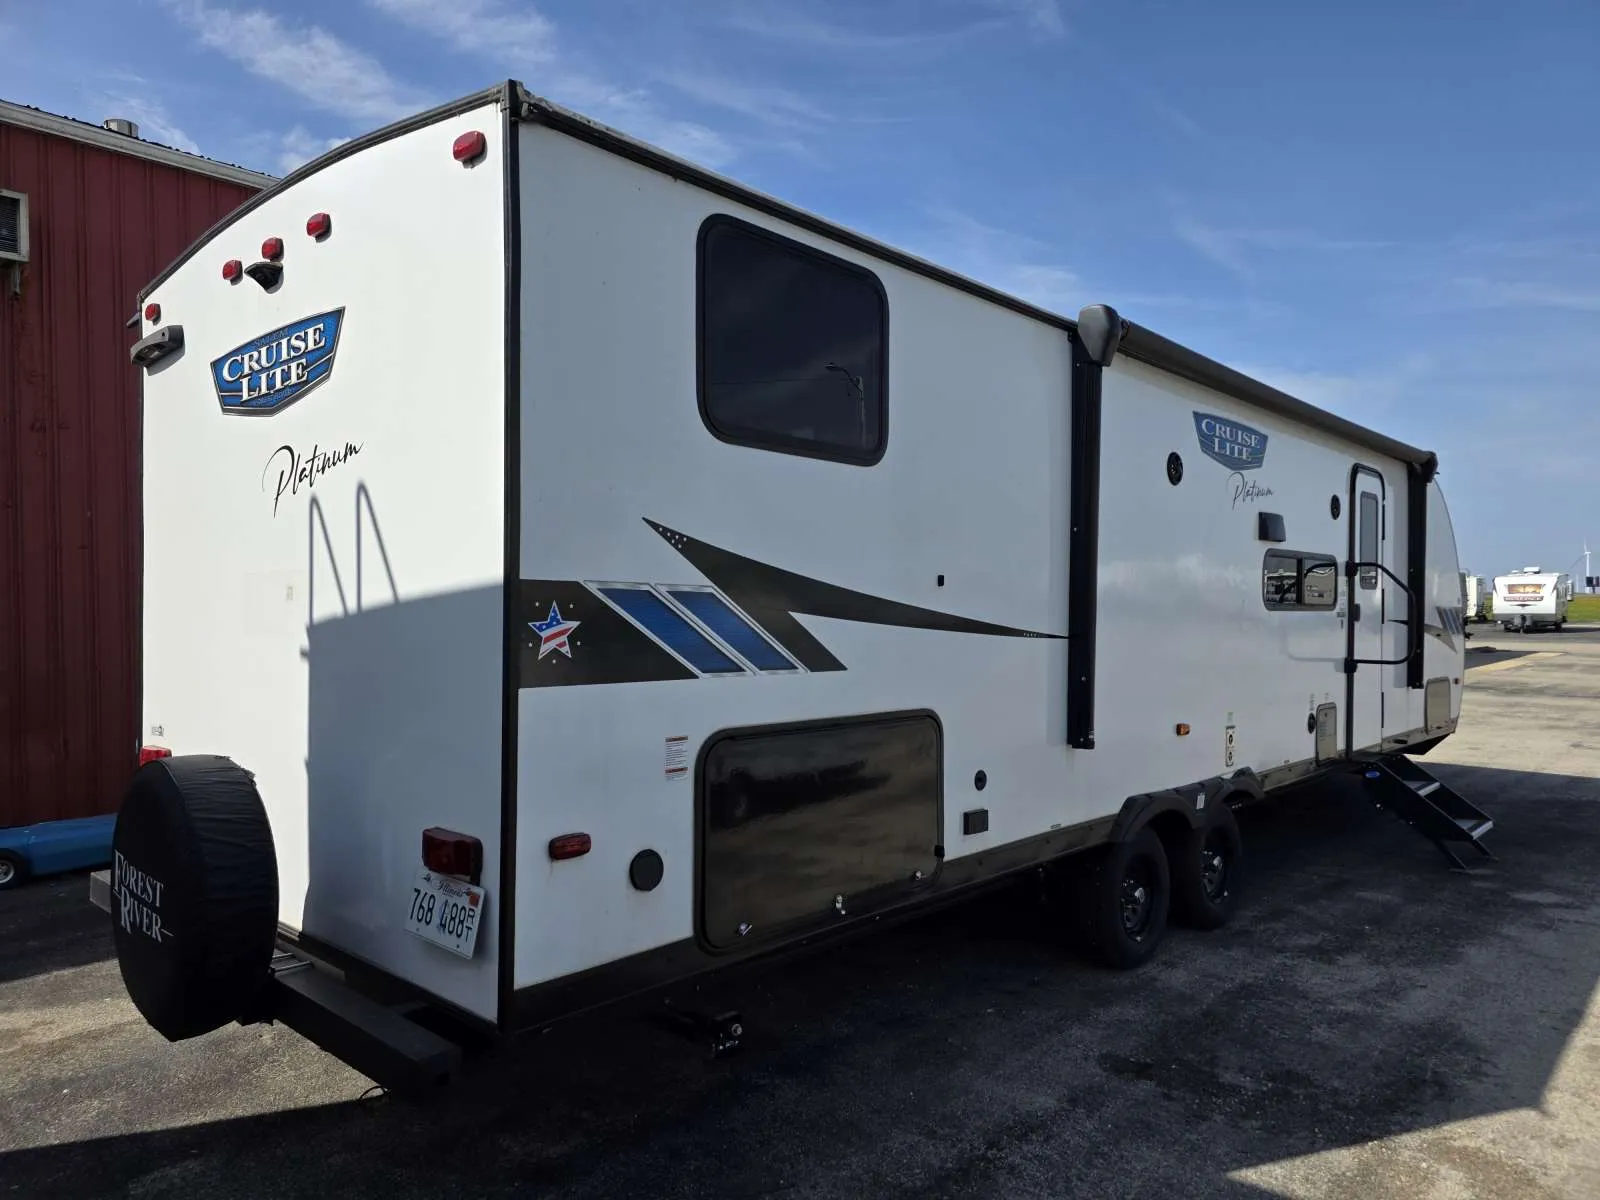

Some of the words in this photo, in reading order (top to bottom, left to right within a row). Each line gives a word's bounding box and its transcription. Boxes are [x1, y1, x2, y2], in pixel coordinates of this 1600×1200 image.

[223, 323, 326, 382] CRUISE
[240, 358, 308, 401] LITE
[1201, 419, 1261, 449] CRUISE
[1213, 437, 1252, 461] LITE
[261, 441, 365, 519] Platinum
[1225, 471, 1275, 511] Platinum
[114, 848, 164, 908] FOREST
[120, 884, 162, 942] RIVER
[409, 887, 436, 926] 768
[439, 899, 467, 938] 488
